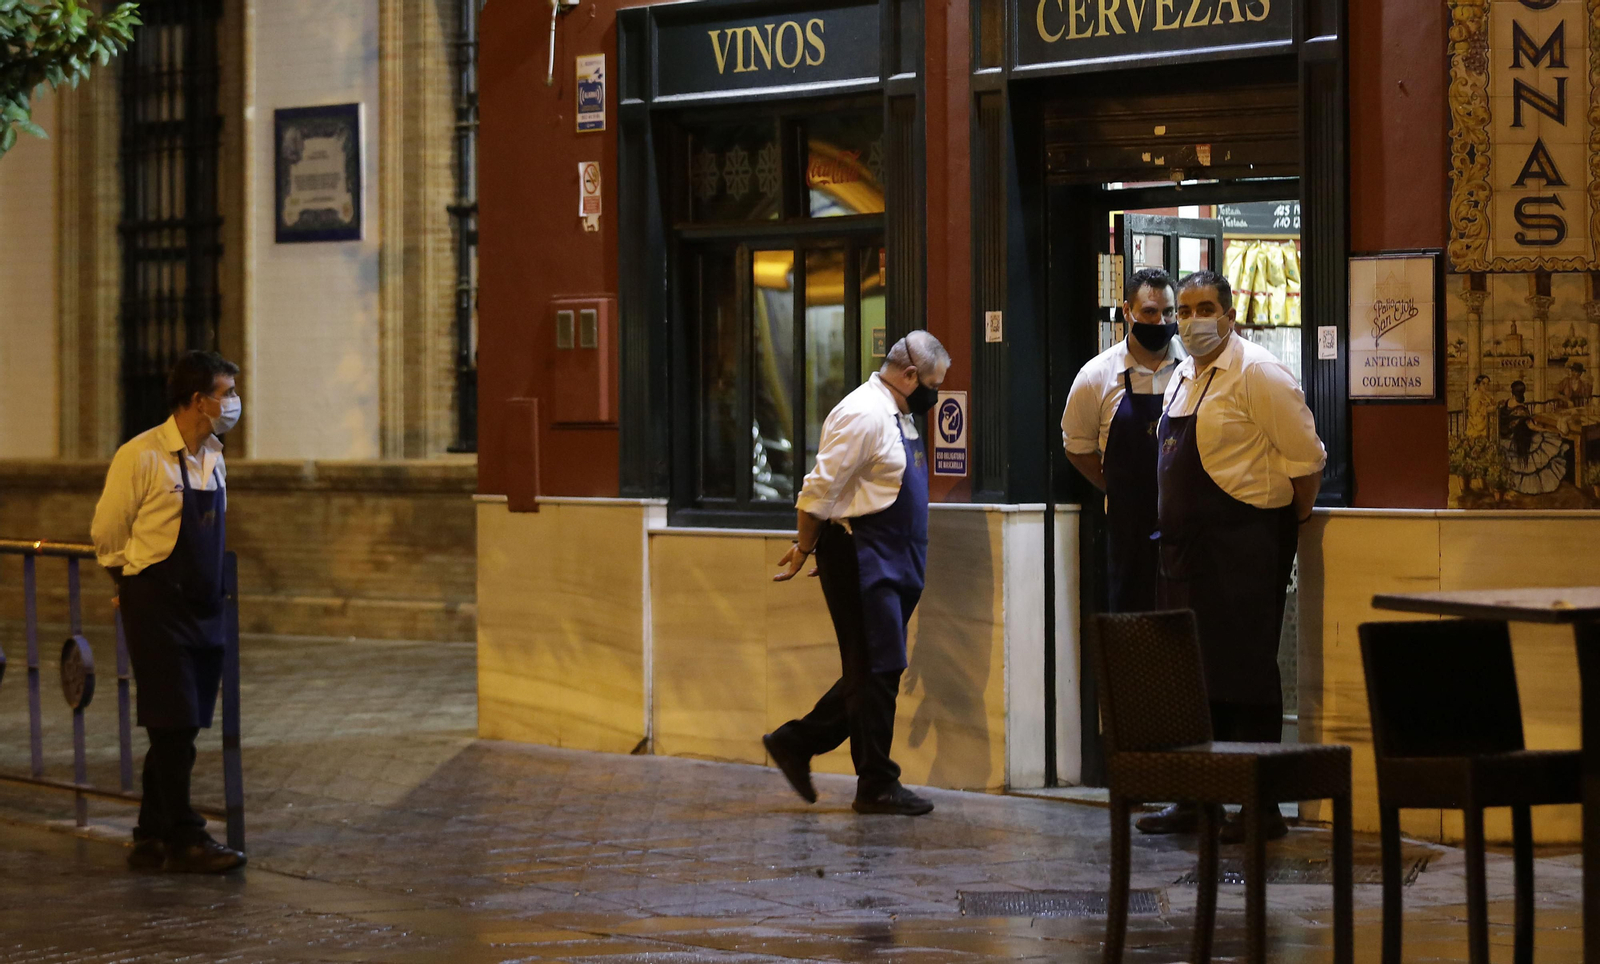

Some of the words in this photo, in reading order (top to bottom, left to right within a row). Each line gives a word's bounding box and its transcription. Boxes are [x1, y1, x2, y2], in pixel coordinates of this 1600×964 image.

[1036, 0, 1271, 43] CERVEZAS
[708, 18, 826, 75] VINOS
[1509, 0, 1569, 246] MNAS
[1371, 314, 1392, 339] San
[1364, 355, 1420, 368] ANTIGUAS
[1362, 376, 1422, 388] COLUMNAS
